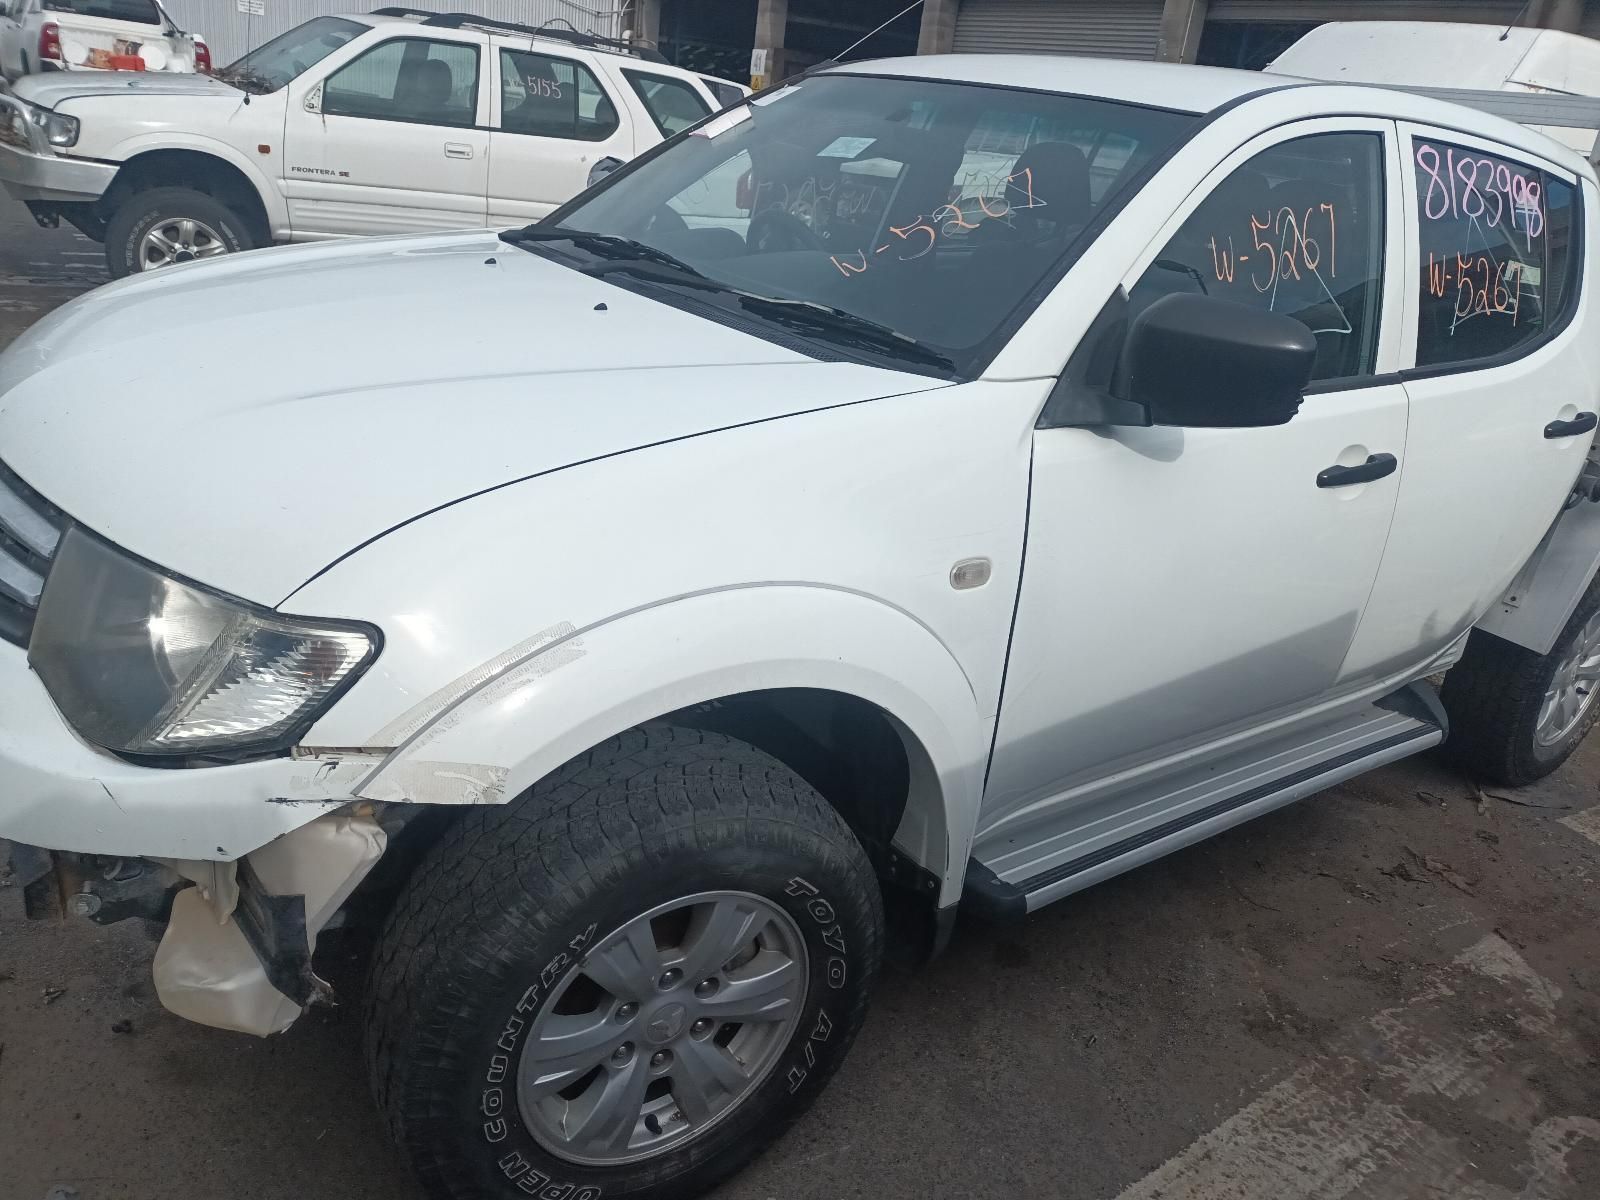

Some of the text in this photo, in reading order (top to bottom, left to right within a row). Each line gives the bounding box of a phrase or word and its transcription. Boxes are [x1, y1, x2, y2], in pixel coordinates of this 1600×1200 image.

[291, 166, 336, 176] FRONTERA
[1416, 144, 1544, 254] 8183998
[1211, 203, 1336, 293] W-5267
[1429, 251, 1521, 327] W-5267
[479, 922, 598, 1143] COUNTRY
[785, 876, 846, 1094] TOYO A/T
